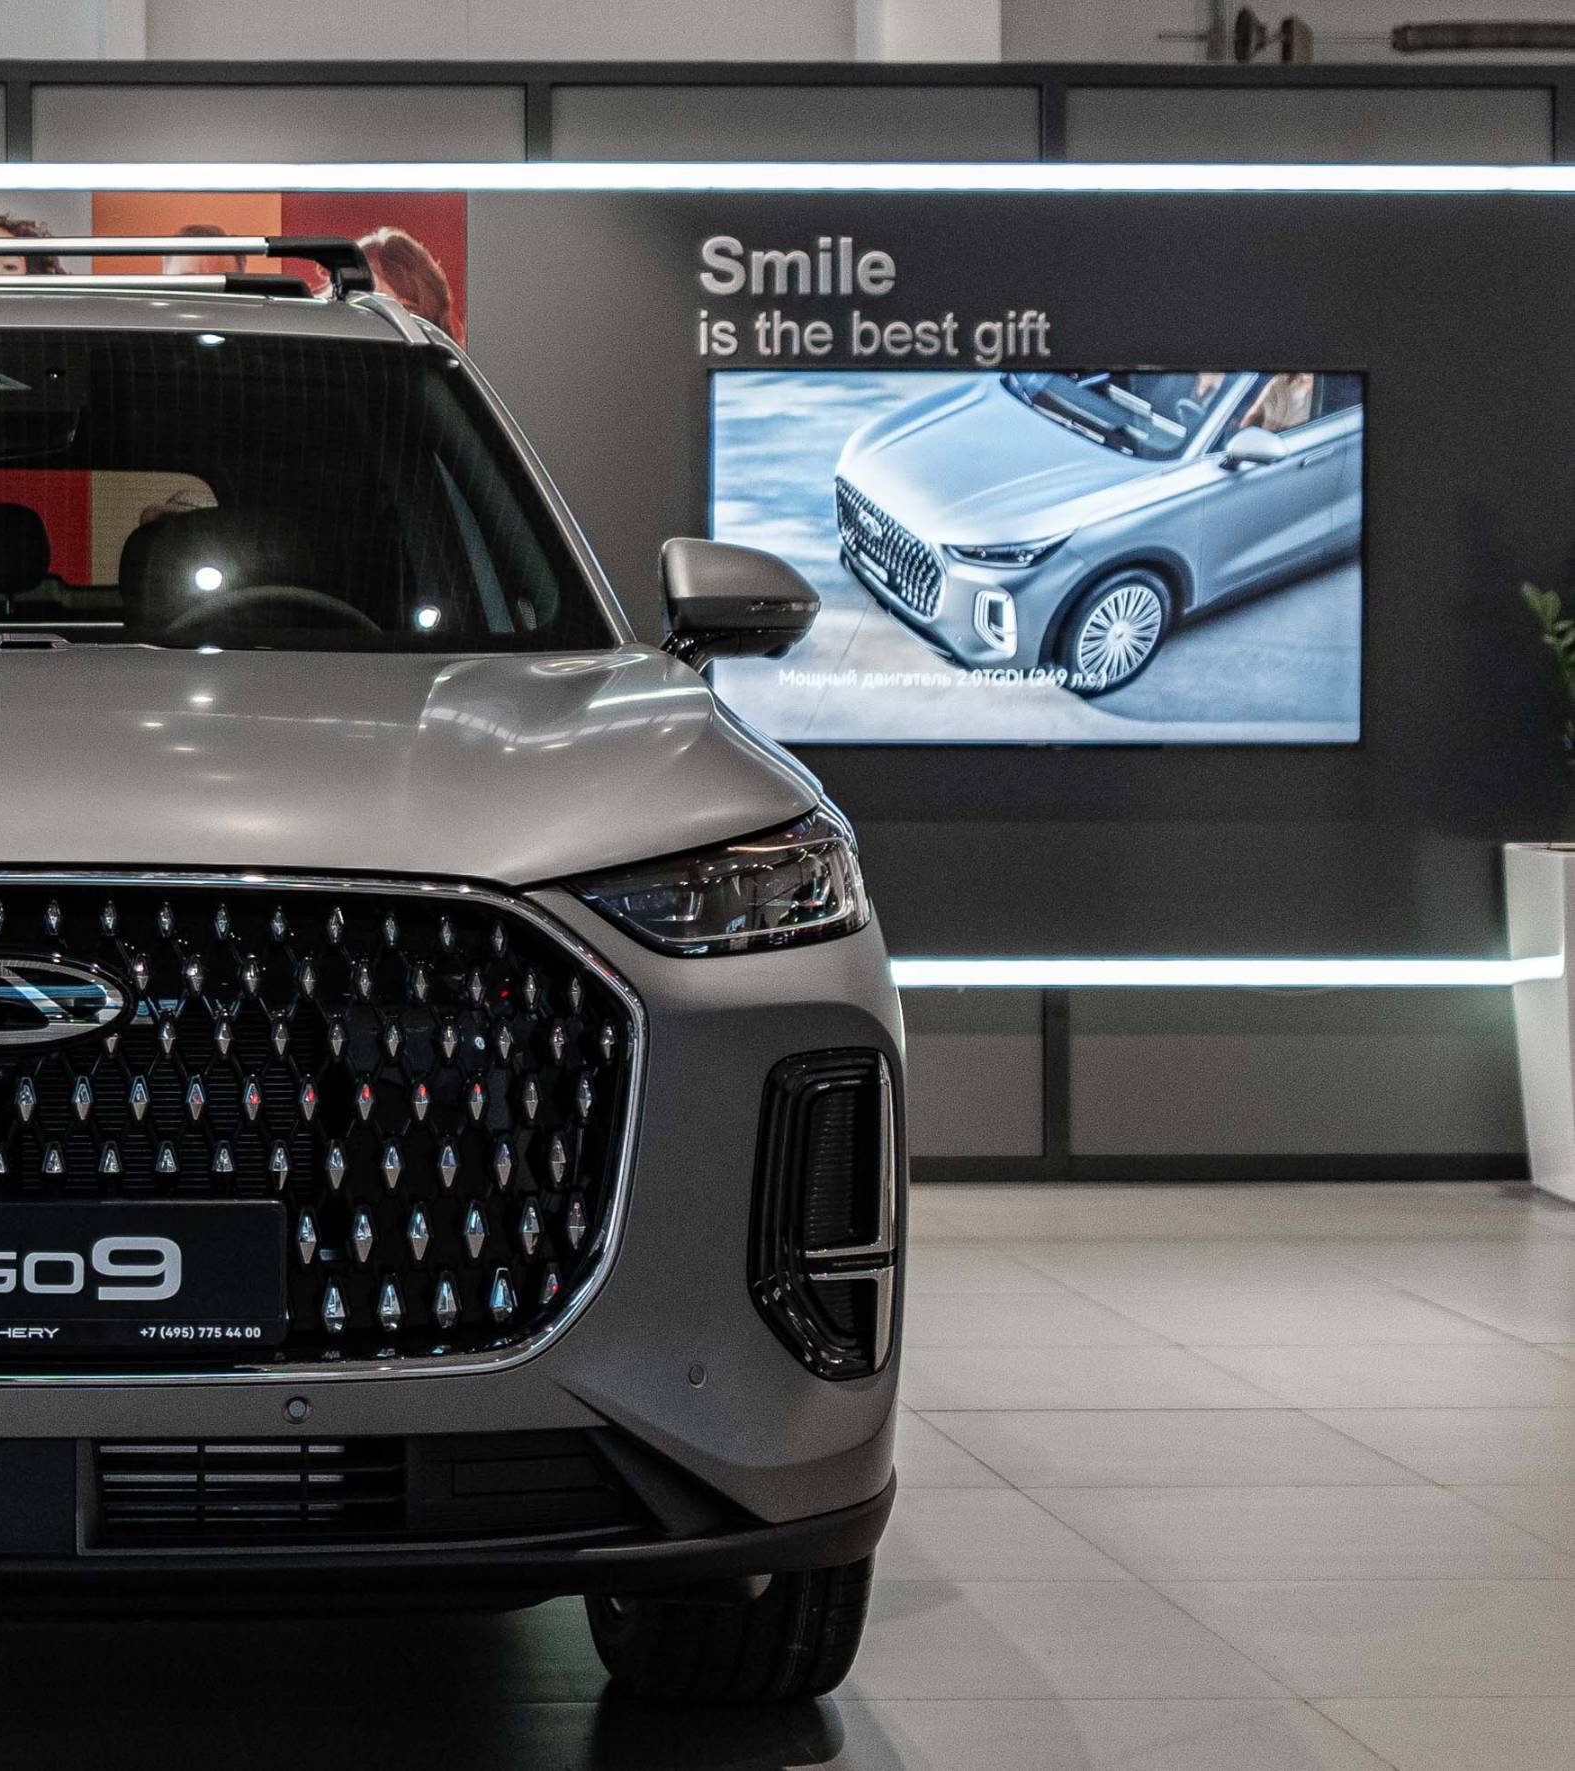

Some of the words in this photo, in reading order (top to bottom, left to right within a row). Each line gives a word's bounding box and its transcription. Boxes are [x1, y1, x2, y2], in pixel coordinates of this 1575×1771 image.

[699, 235, 896, 296] Smile
[699, 310, 738, 355] is
[755, 310, 834, 355] the
[852, 310, 958, 355] best
[974, 310, 1050, 365] gift
[778, 669, 858, 689] Мощный
[861, 671, 952, 689] двигатель
[955, 668, 1024, 688] 2.0TGDI
[1028, 667, 1068, 689] (249
[140, 1326, 156, 1338] +7
[160, 1325, 195, 1339] (495)
[198, 1326, 222, 1338] 775
[225, 1326, 242, 1338] 44
[245, 1326, 261, 1338] 00
